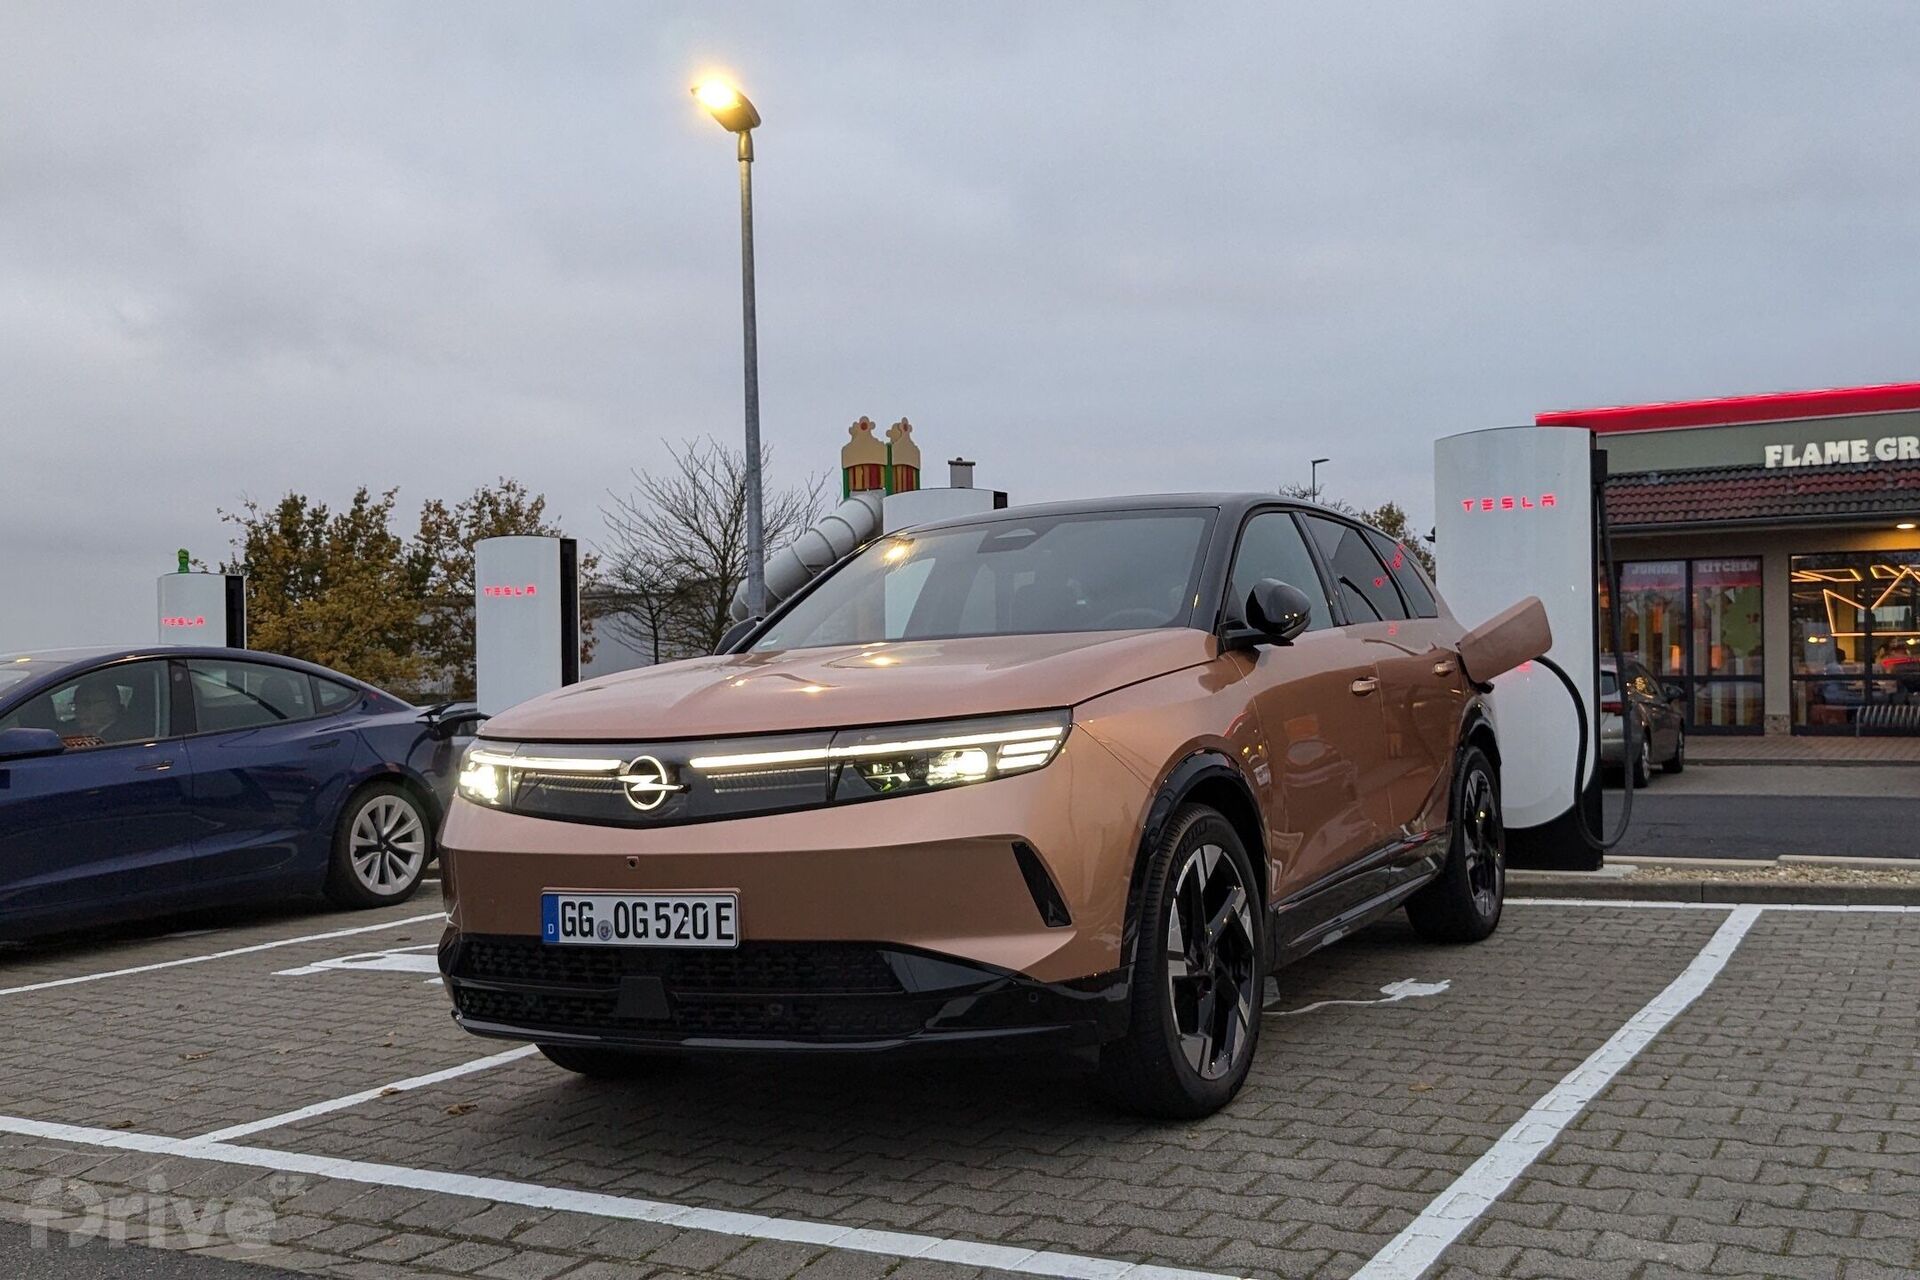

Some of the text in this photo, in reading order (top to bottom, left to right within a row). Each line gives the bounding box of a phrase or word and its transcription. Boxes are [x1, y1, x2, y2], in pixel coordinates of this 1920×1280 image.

[1764, 439, 1869, 468] FLAME
[1462, 494, 1555, 512] TESLA
[1632, 561, 1758, 575] JUNIOR KITCHEN
[484, 585, 536, 596] TESLA
[162, 616, 204, 627] TESLA
[561, 901, 594, 938] GG
